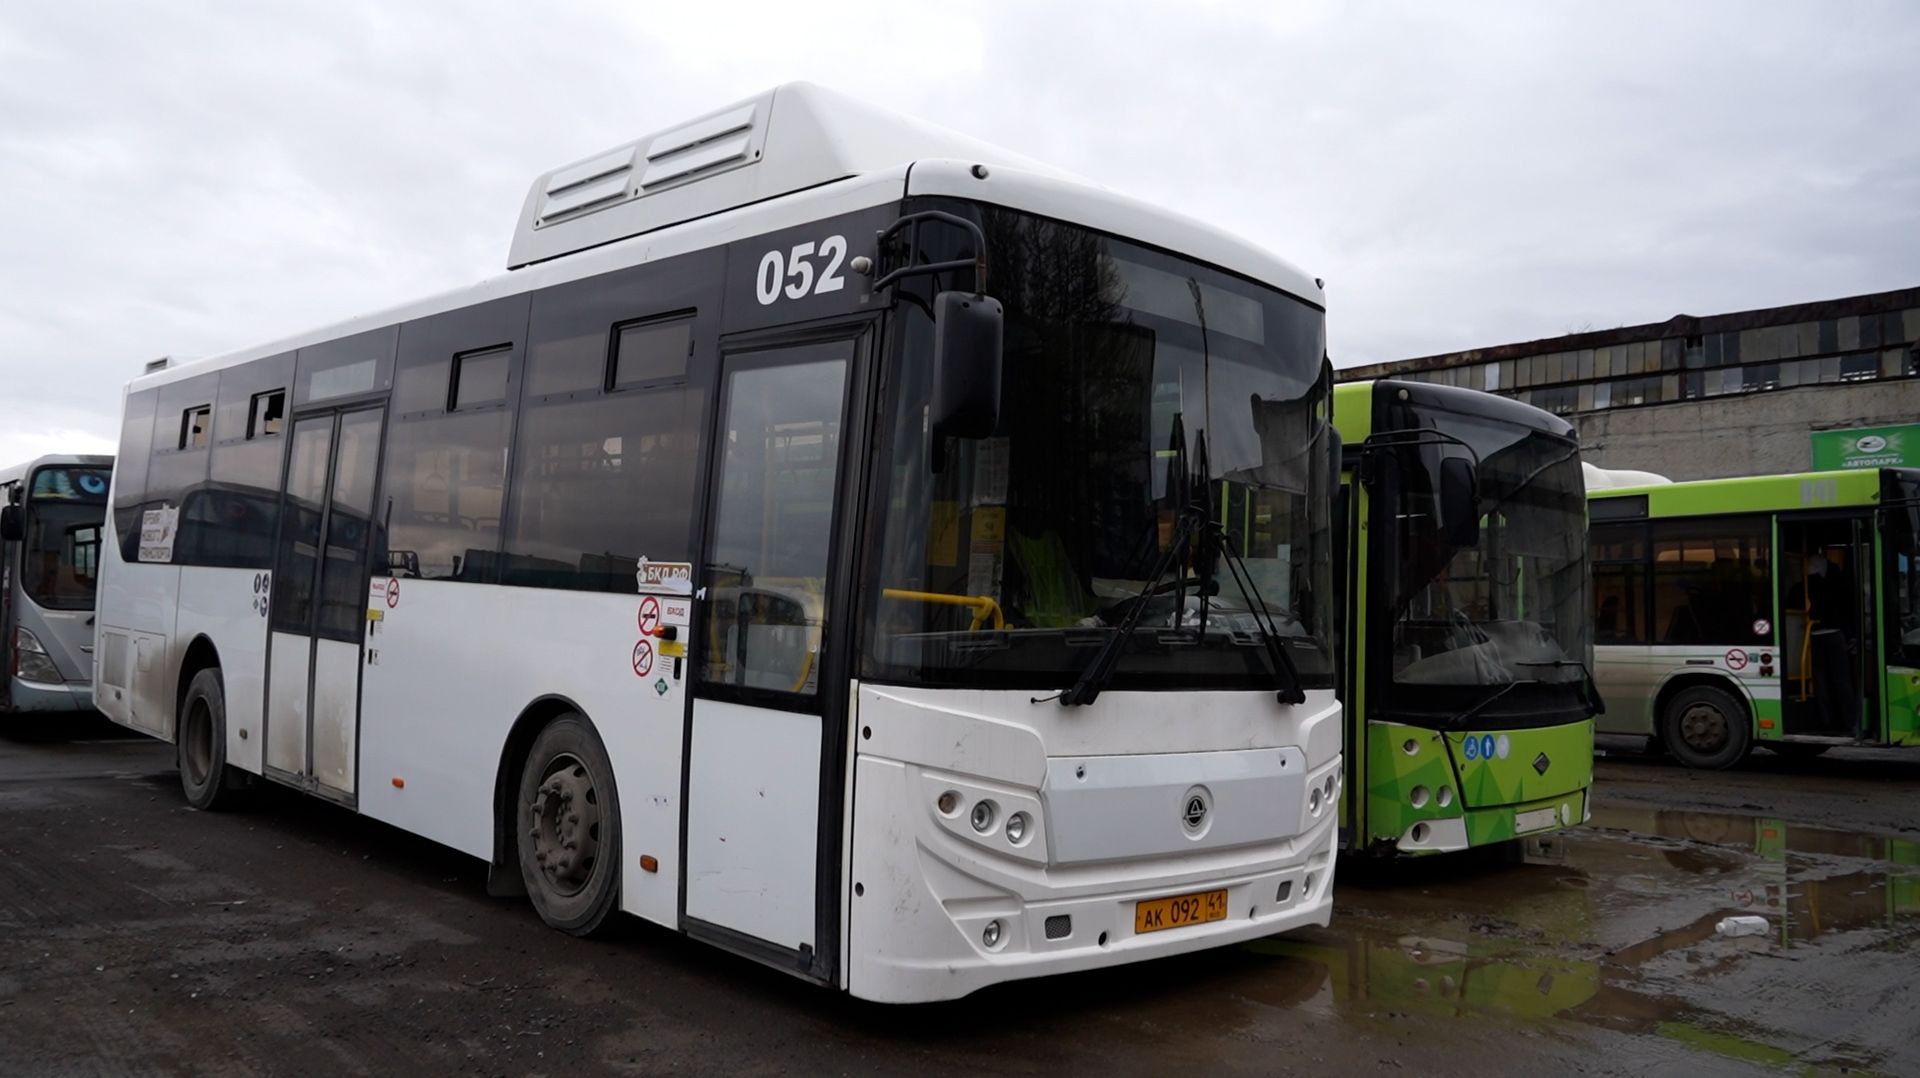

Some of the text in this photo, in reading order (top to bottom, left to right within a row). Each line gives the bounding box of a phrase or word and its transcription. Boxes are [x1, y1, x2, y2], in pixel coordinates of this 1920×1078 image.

[756, 235, 848, 306] 052
[1144, 893, 1223, 928] АК 092 41
